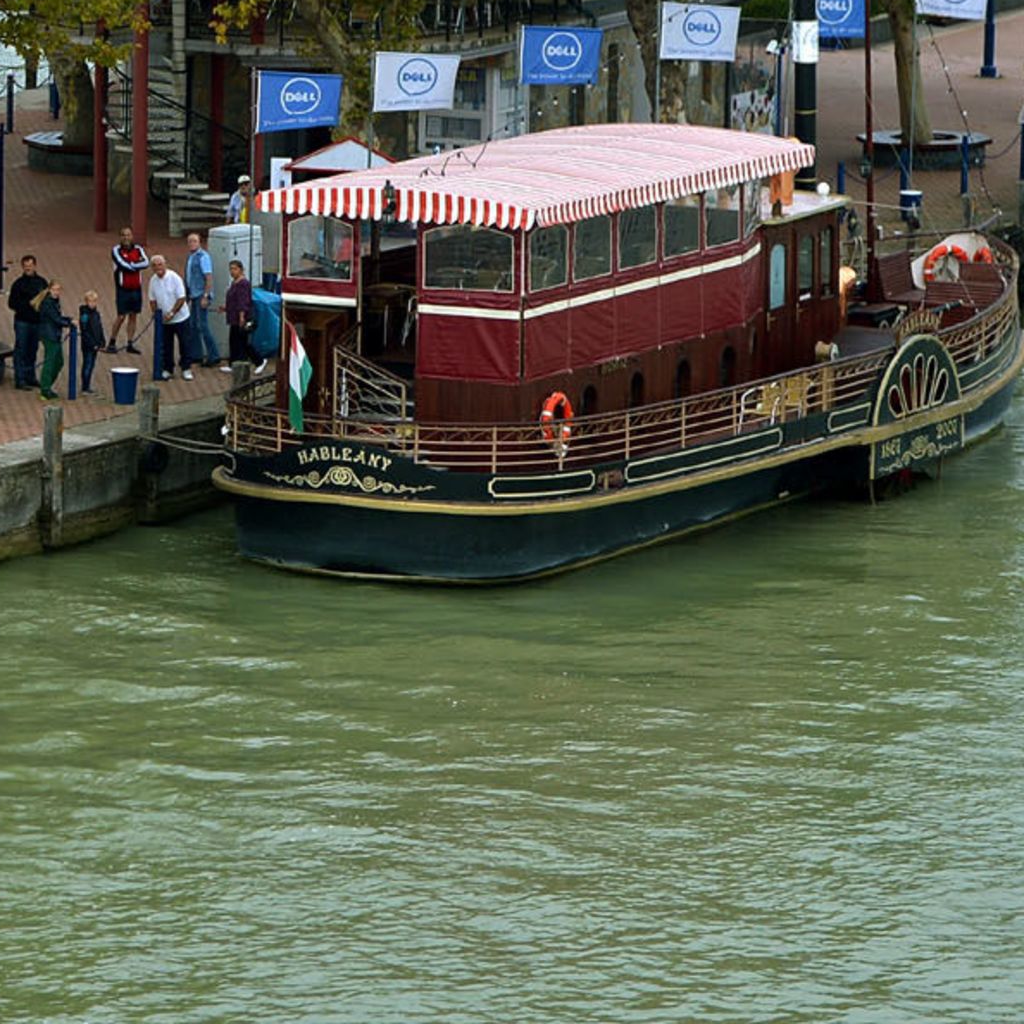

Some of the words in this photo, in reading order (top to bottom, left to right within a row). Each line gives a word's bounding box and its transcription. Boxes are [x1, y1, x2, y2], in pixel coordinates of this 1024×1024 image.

[819, 0, 847, 11] DELL
[687, 22, 716, 33] DELL
[547, 45, 577, 56] DELL
[402, 72, 432, 82] DELL
[285, 91, 316, 102] DELL
